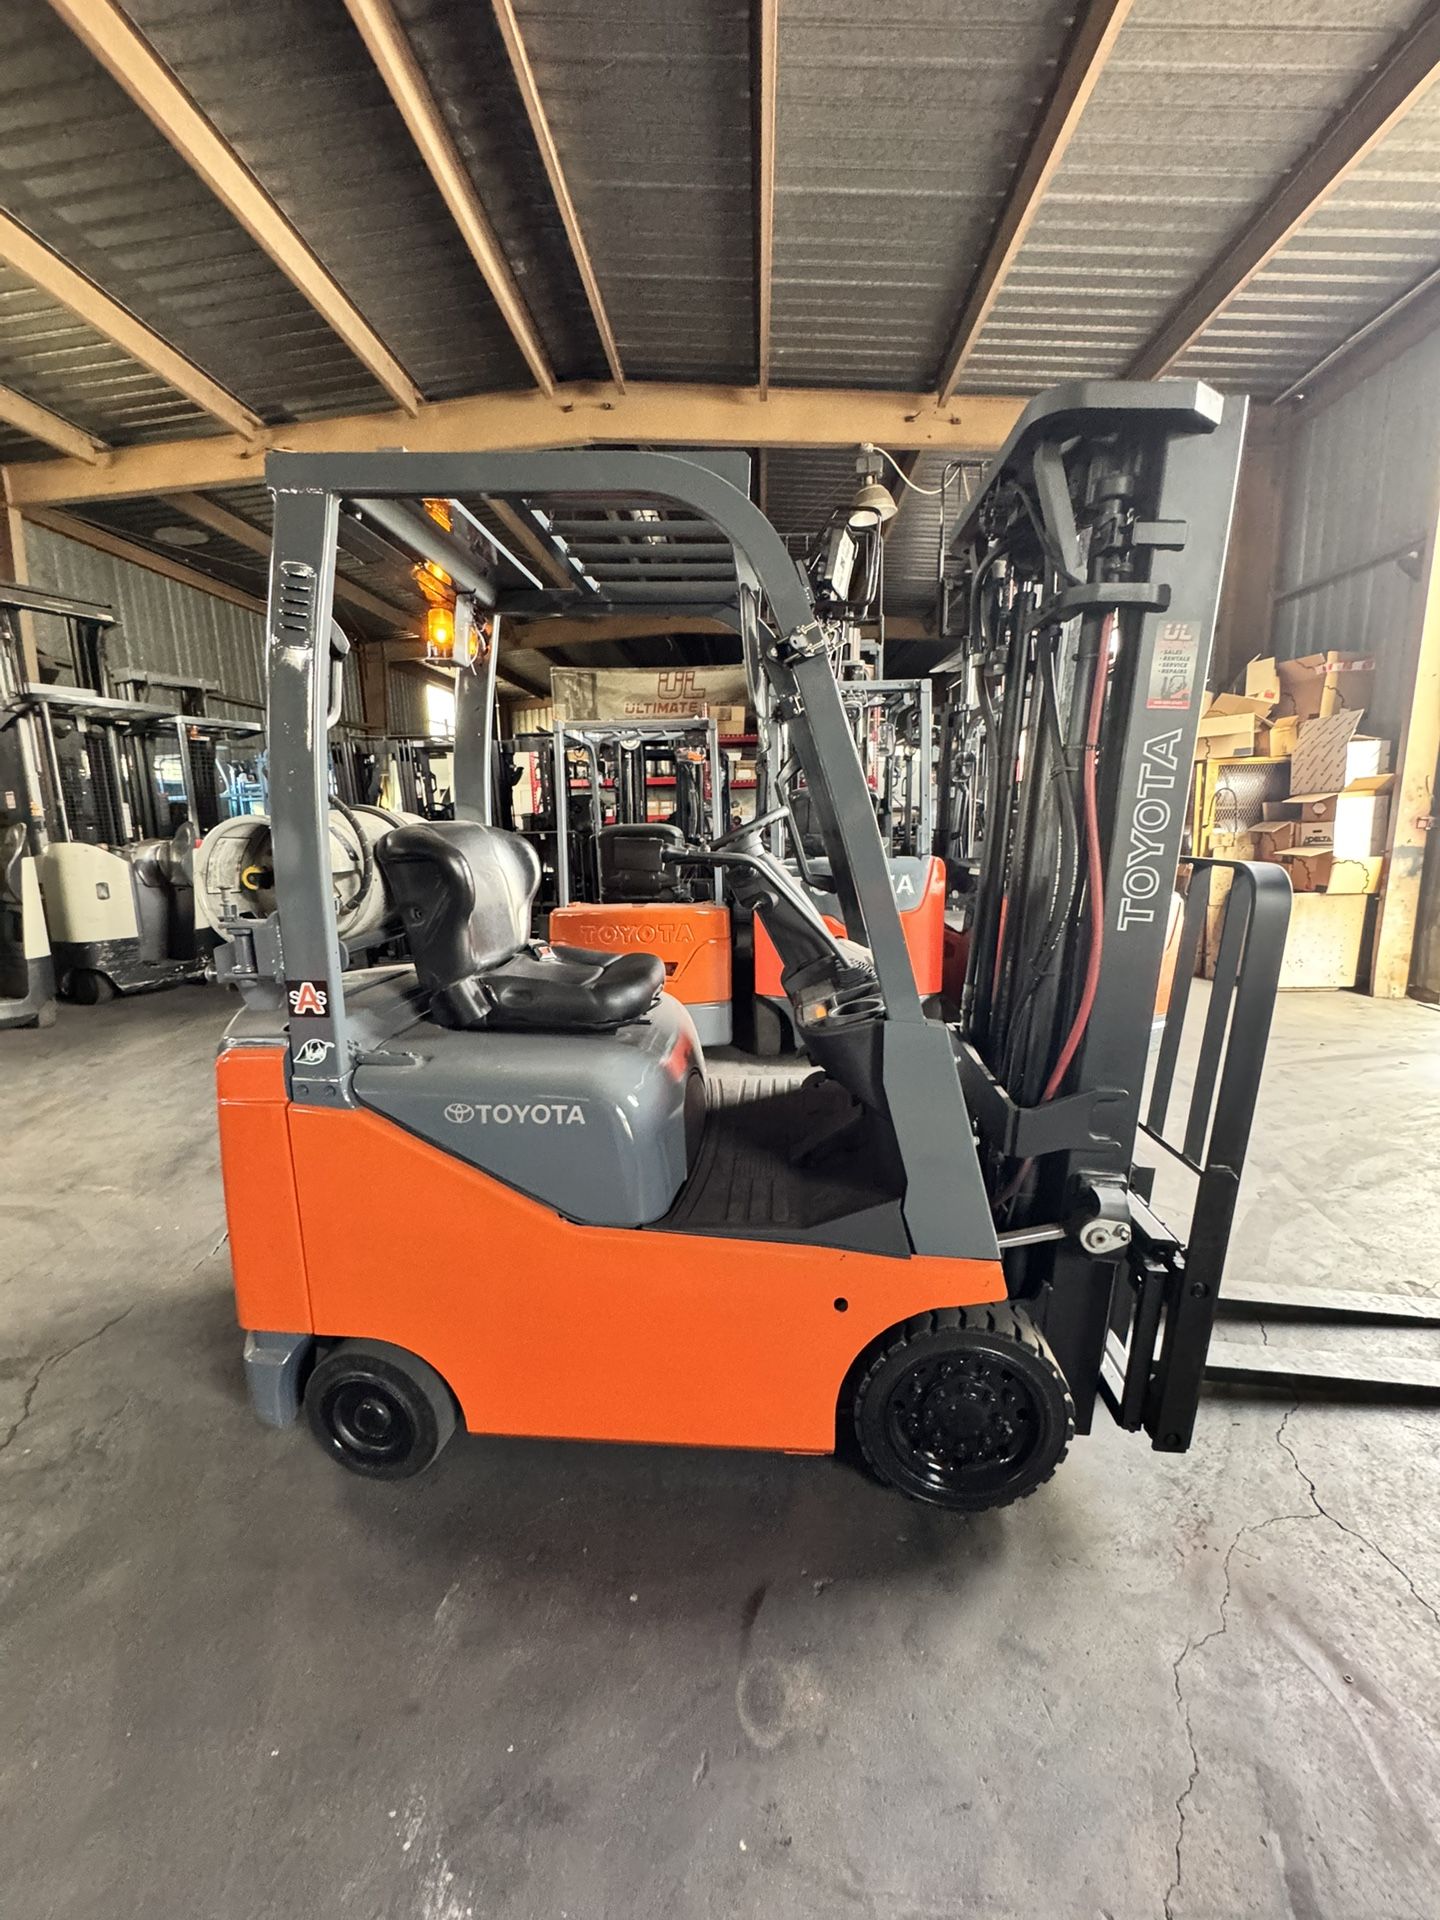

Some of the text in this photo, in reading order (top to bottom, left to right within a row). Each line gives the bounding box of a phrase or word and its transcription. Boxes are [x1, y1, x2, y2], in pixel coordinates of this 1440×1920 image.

[625, 702, 698, 715] ULTIMATE
[1117, 728, 1183, 931] TOYOTA
[580, 923, 695, 945] TOYOTA
[475, 1104, 586, 1125] TOYOTA
